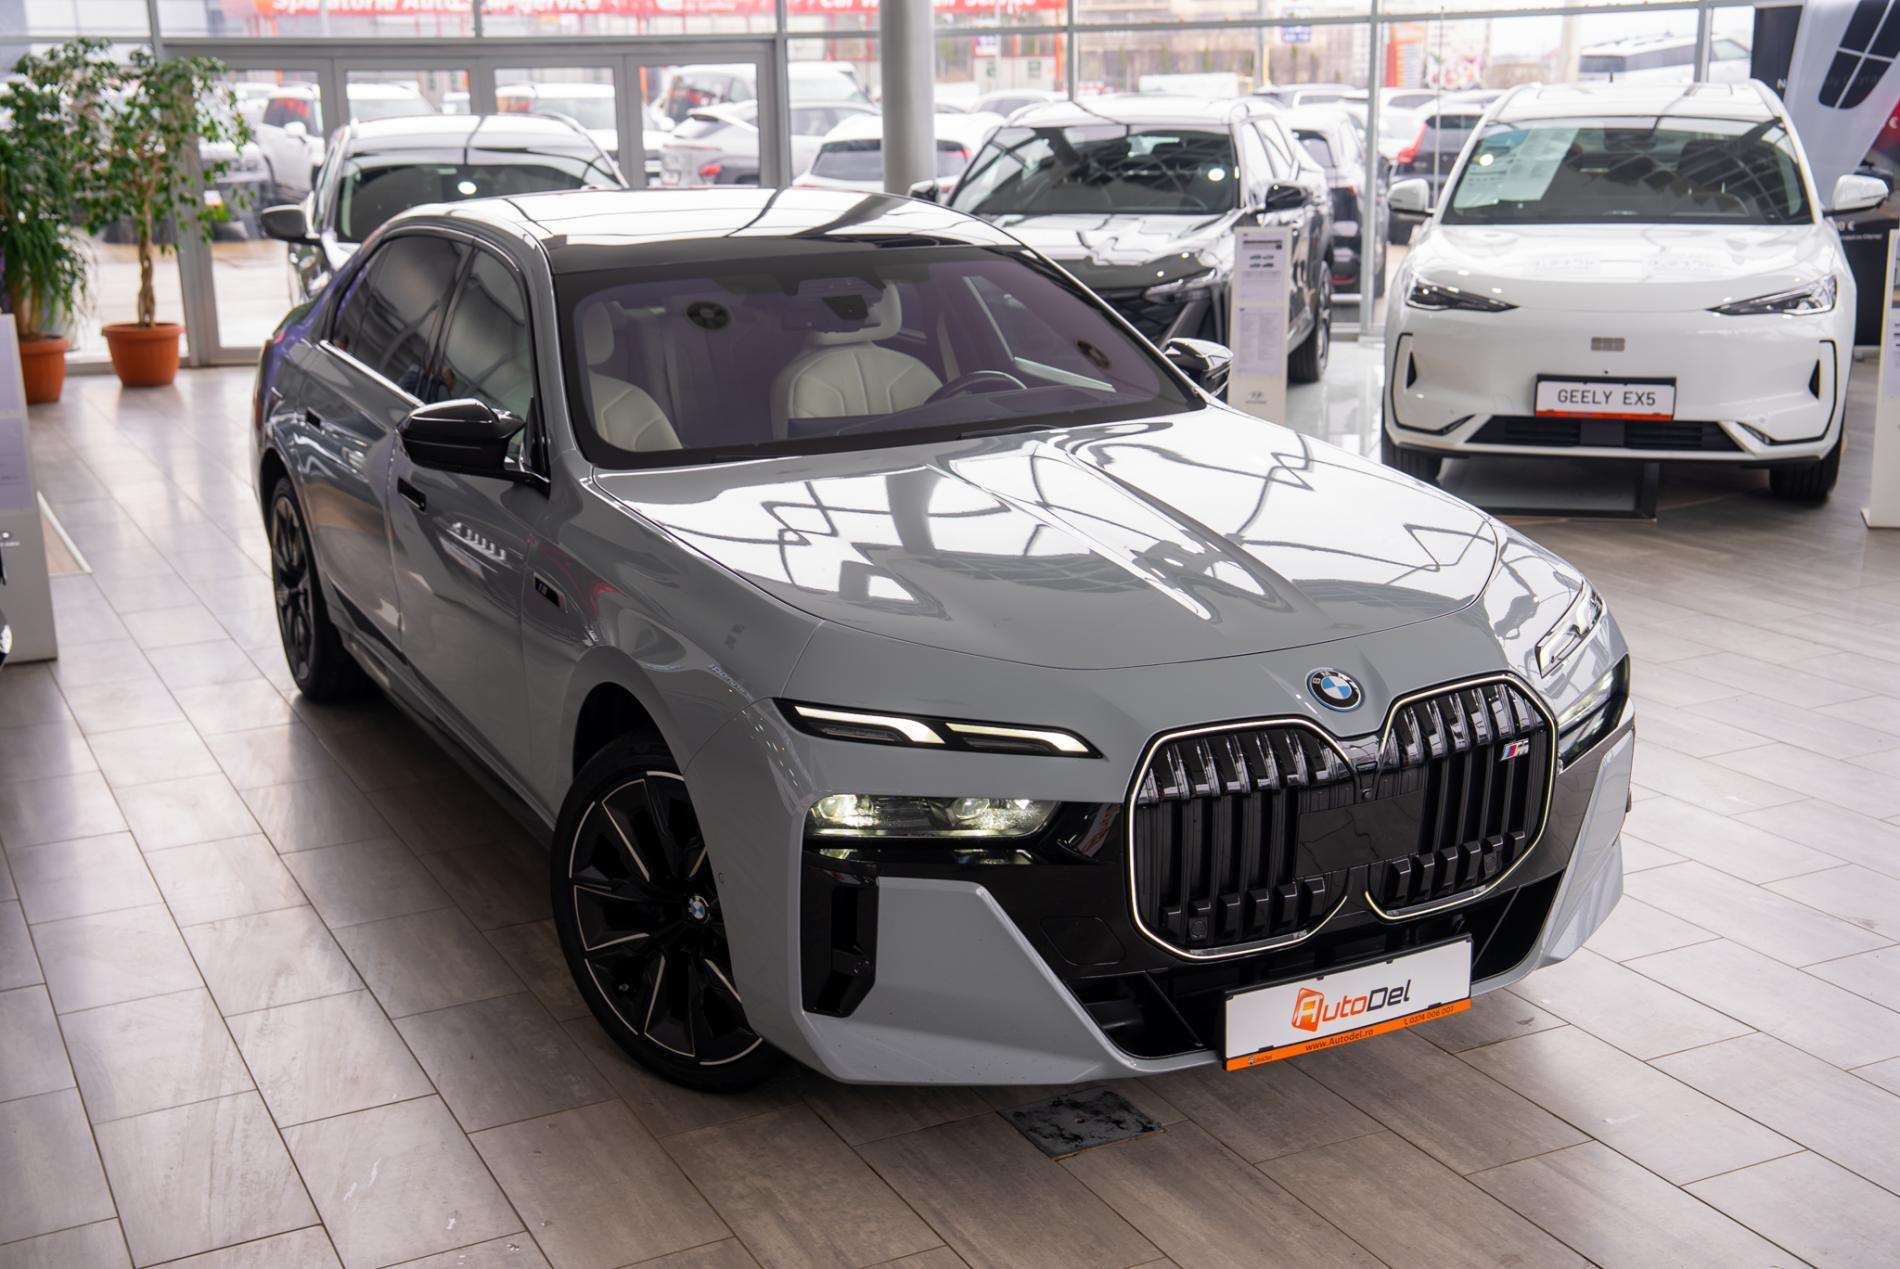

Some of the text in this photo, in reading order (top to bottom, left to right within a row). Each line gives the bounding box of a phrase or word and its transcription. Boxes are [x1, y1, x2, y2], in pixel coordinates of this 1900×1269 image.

[1557, 388, 1657, 407] GEELY EX5
[1293, 979, 1412, 1031] AutoDel
